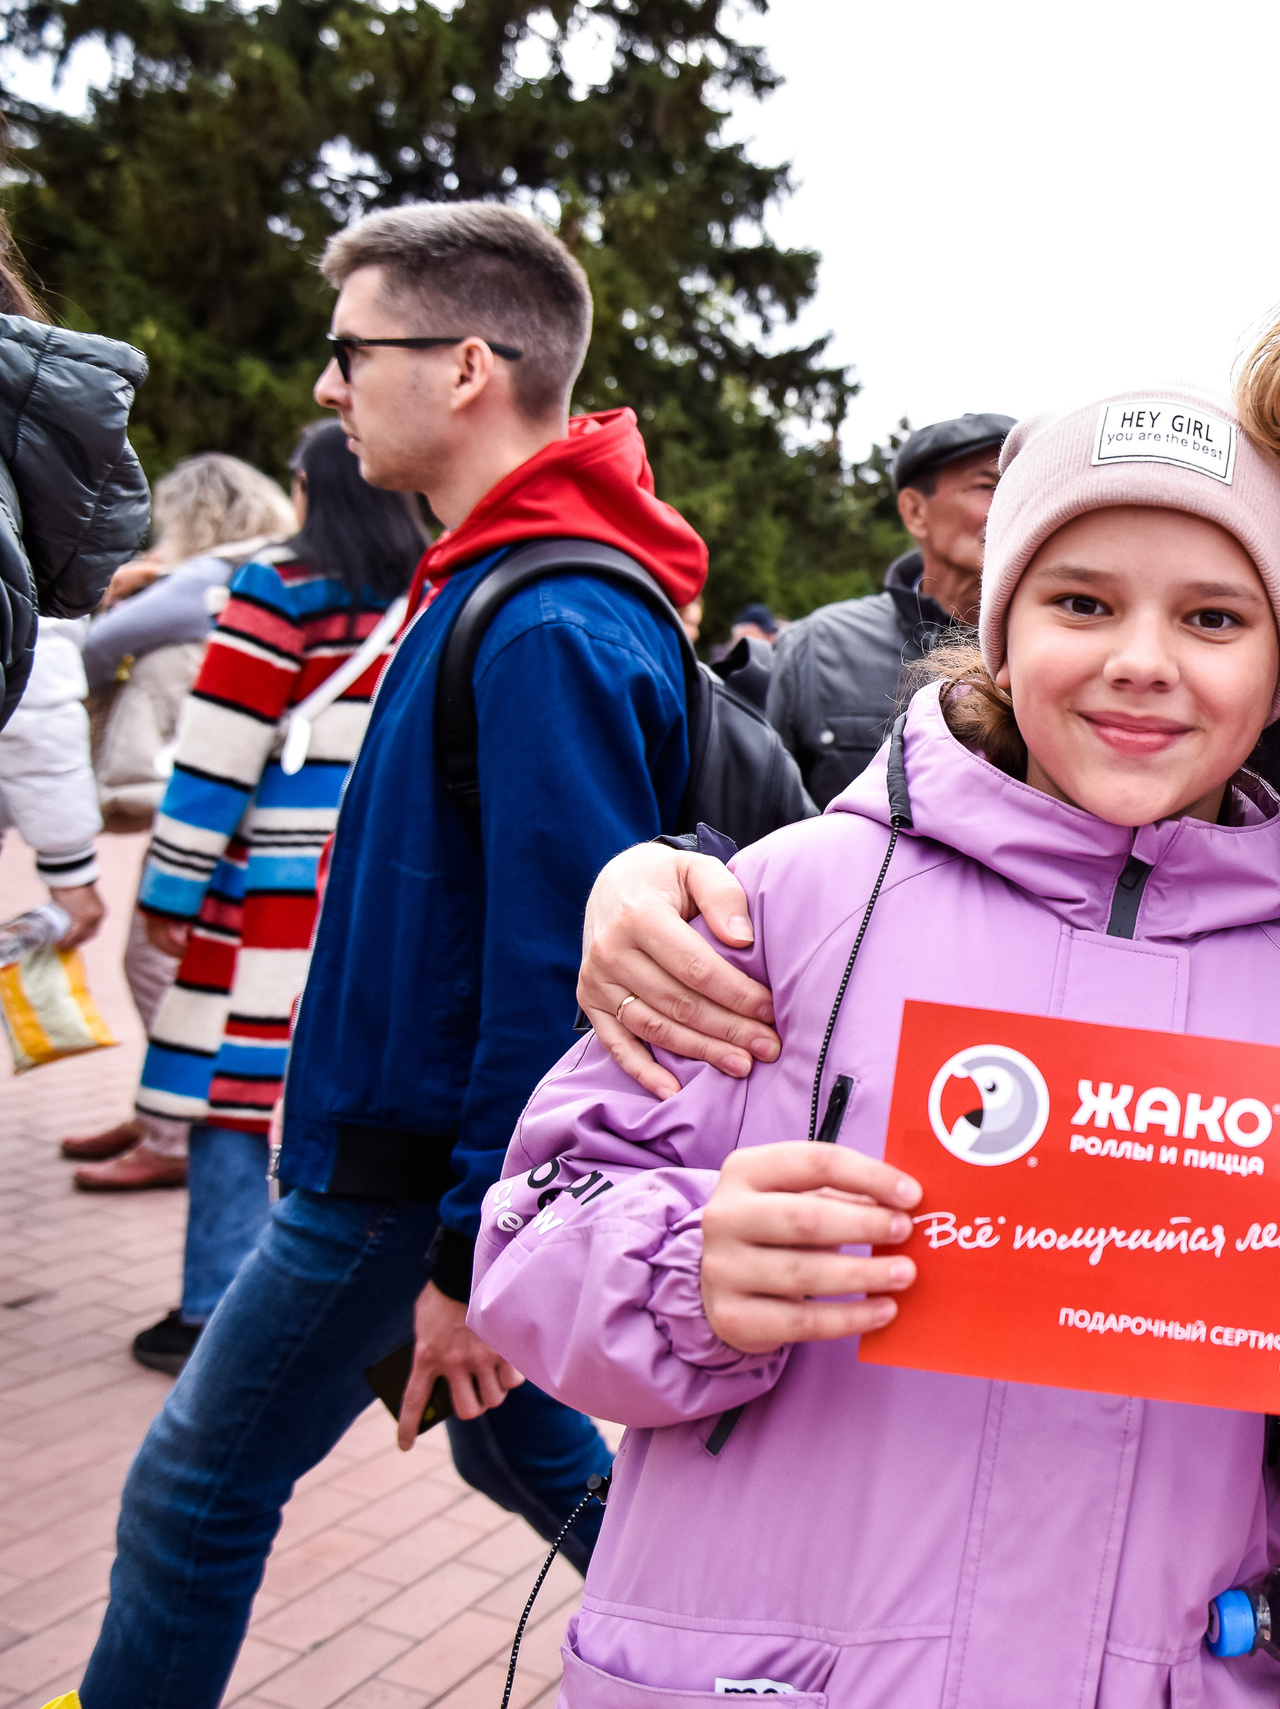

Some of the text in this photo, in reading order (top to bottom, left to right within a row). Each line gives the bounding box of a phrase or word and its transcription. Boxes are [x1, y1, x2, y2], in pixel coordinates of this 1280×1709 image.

[1107, 432, 1223, 460] you are the best
[1121, 411, 1213, 442] HEY GIRL
[1070, 1079, 1273, 1148] ЖАКО
[1070, 1134, 1265, 1177] РОЛЛЫ И ПИЦЦА
[1013, 1216, 1226, 1266] получится
[1058, 1307, 1206, 1342] ПОДАРОЧНЫЙ
